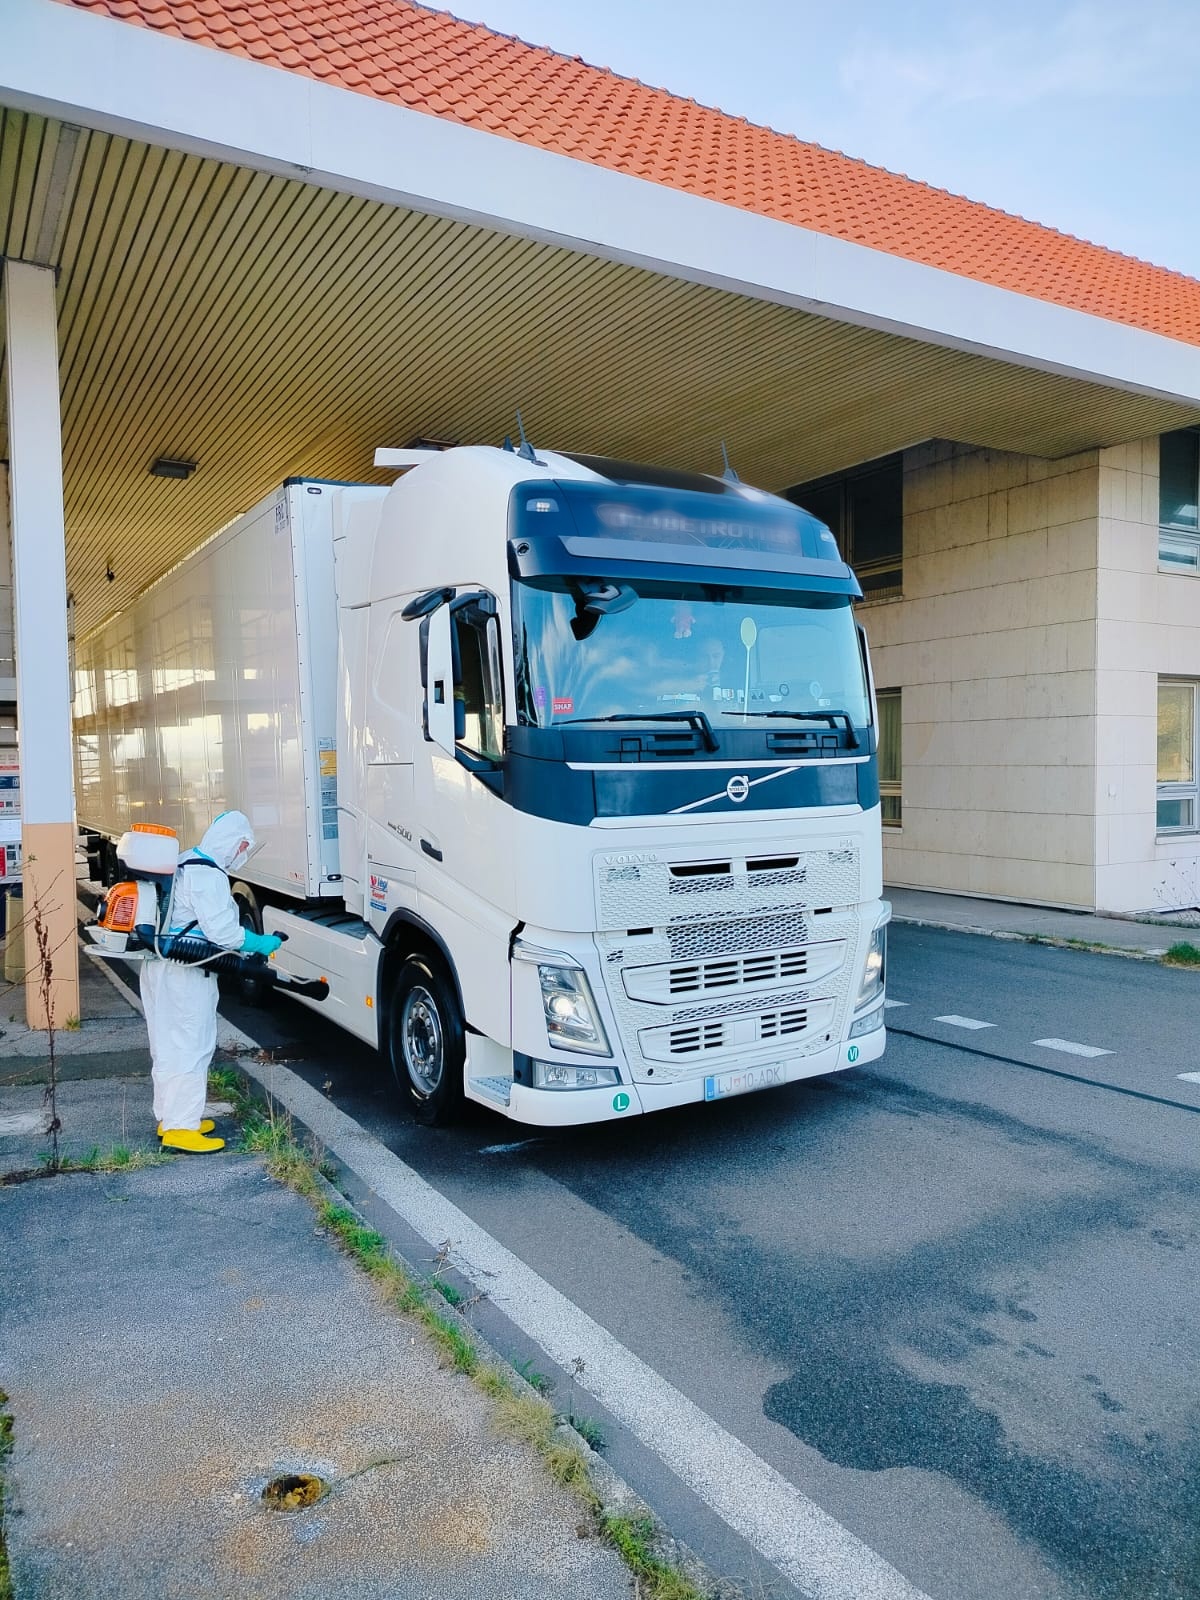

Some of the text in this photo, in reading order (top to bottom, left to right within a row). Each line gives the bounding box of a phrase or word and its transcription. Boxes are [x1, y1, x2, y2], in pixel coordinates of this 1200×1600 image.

[396, 824, 412, 841] 500
[603, 853, 659, 865] VOLVO
[718, 1067, 782, 1094] LJ 10-ADK
[617, 1095, 627, 1110] L
